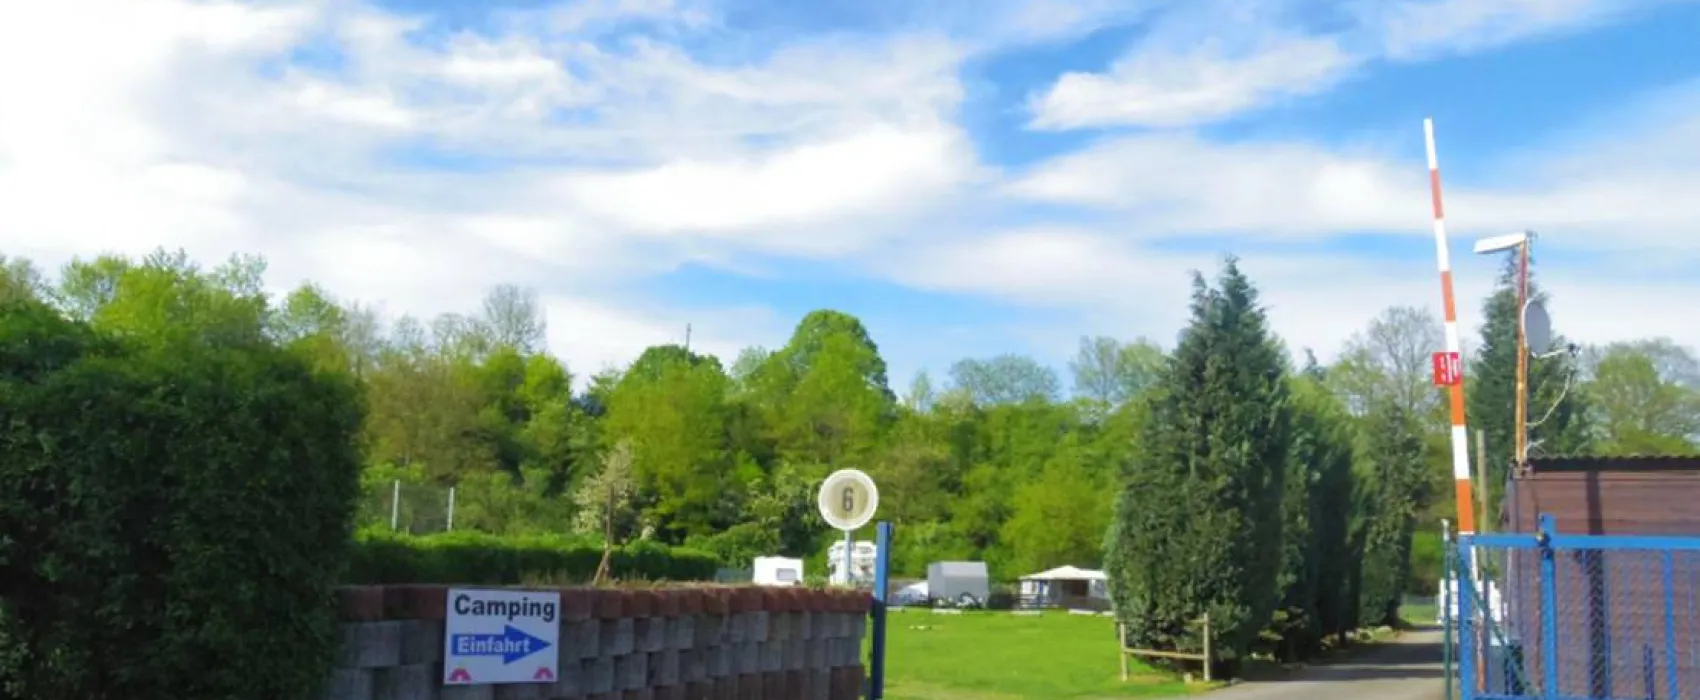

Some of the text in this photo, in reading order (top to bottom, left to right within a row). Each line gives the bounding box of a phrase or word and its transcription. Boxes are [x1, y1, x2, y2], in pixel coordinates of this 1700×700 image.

[843, 486, 854, 512] 6
[454, 593, 555, 622] Camping
[457, 636, 531, 653] Einfahrt
